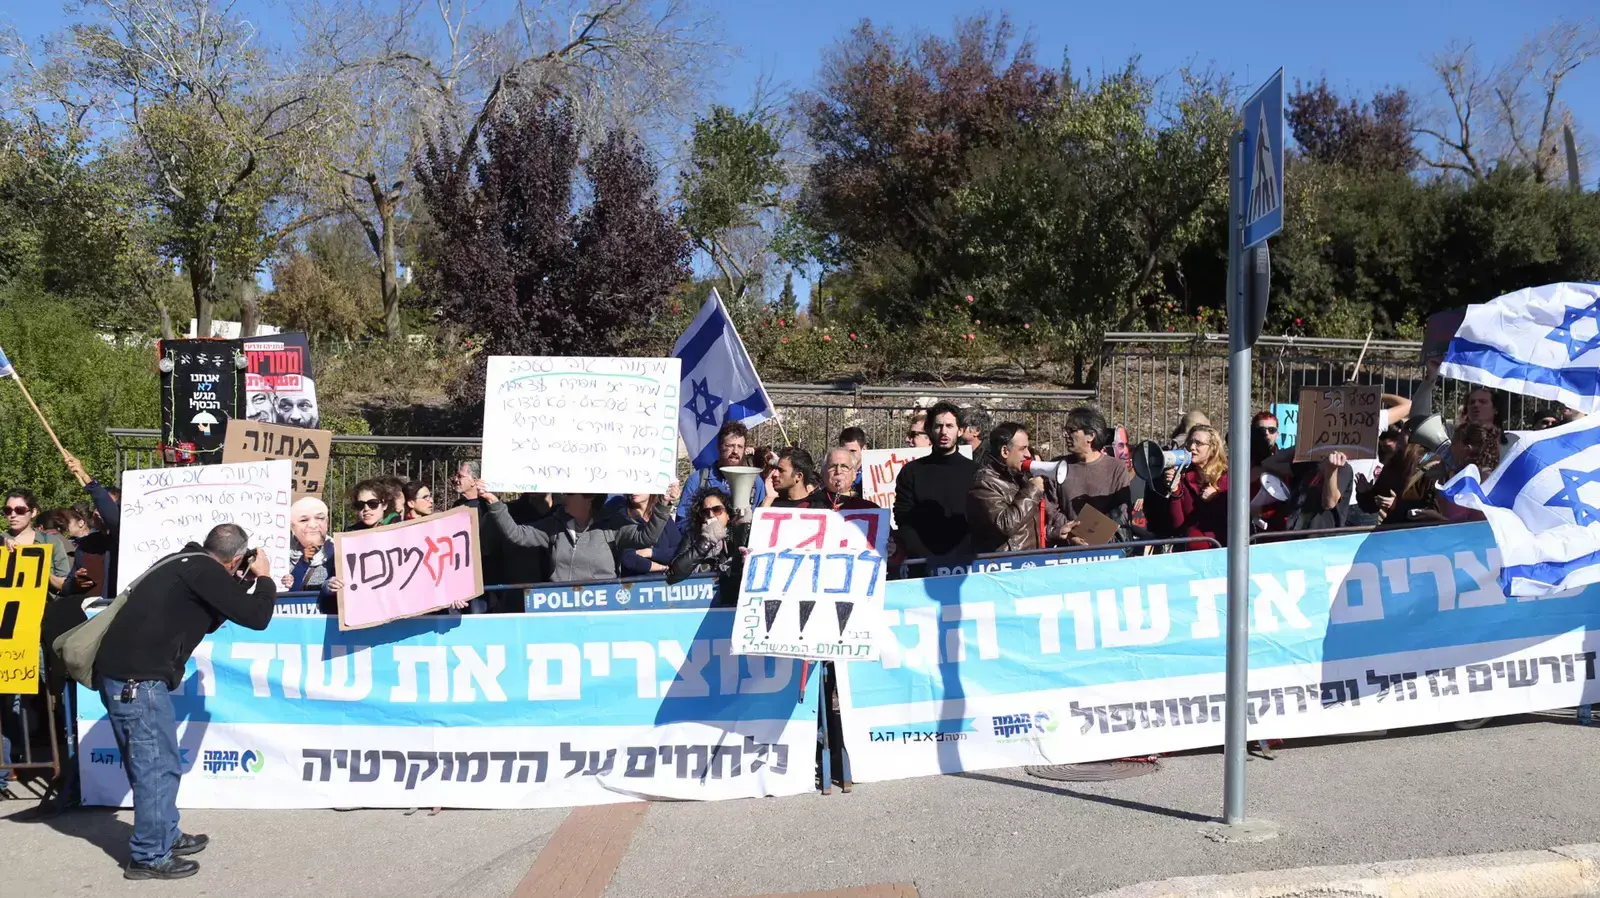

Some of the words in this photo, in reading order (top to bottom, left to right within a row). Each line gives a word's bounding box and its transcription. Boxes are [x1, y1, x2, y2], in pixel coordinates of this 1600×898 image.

[190, 374, 220, 383] אנחנו
[197, 381, 212, 391] לא
[189, 399, 221, 411] הכסף!
[193, 392, 216, 400] מגש
[1325, 411, 1377, 428] עבודה
[242, 430, 320, 459] מתווה
[221, 465, 270, 485] מתווה
[760, 512, 880, 550] הגז
[346, 530, 470, 591] הגזמתם!
[744, 548, 882, 597] לכולם
[533, 589, 608, 609] POLICE
[639, 583, 714, 603] משטרה
[1014, 583, 1170, 655] שוד
[231, 642, 374, 702] שוד
[389, 645, 507, 703] את
[527, 638, 795, 700] עוצרים
[1467, 651, 1598, 694] דורשים
[1366, 669, 1418, 703] זול
[1425, 668, 1460, 698] גז
[992, 711, 1031, 726] מגמה
[993, 723, 1033, 738] ירוקה
[868, 731, 895, 742] הגז
[90, 752, 114, 765] הגז
[203, 750, 239, 761] מגמה
[203, 760, 238, 774] ירוקה
[559, 742, 618, 780] על
[624, 735, 789, 783] נלחמים
[302, 749, 548, 790] הדמוקרטיה
